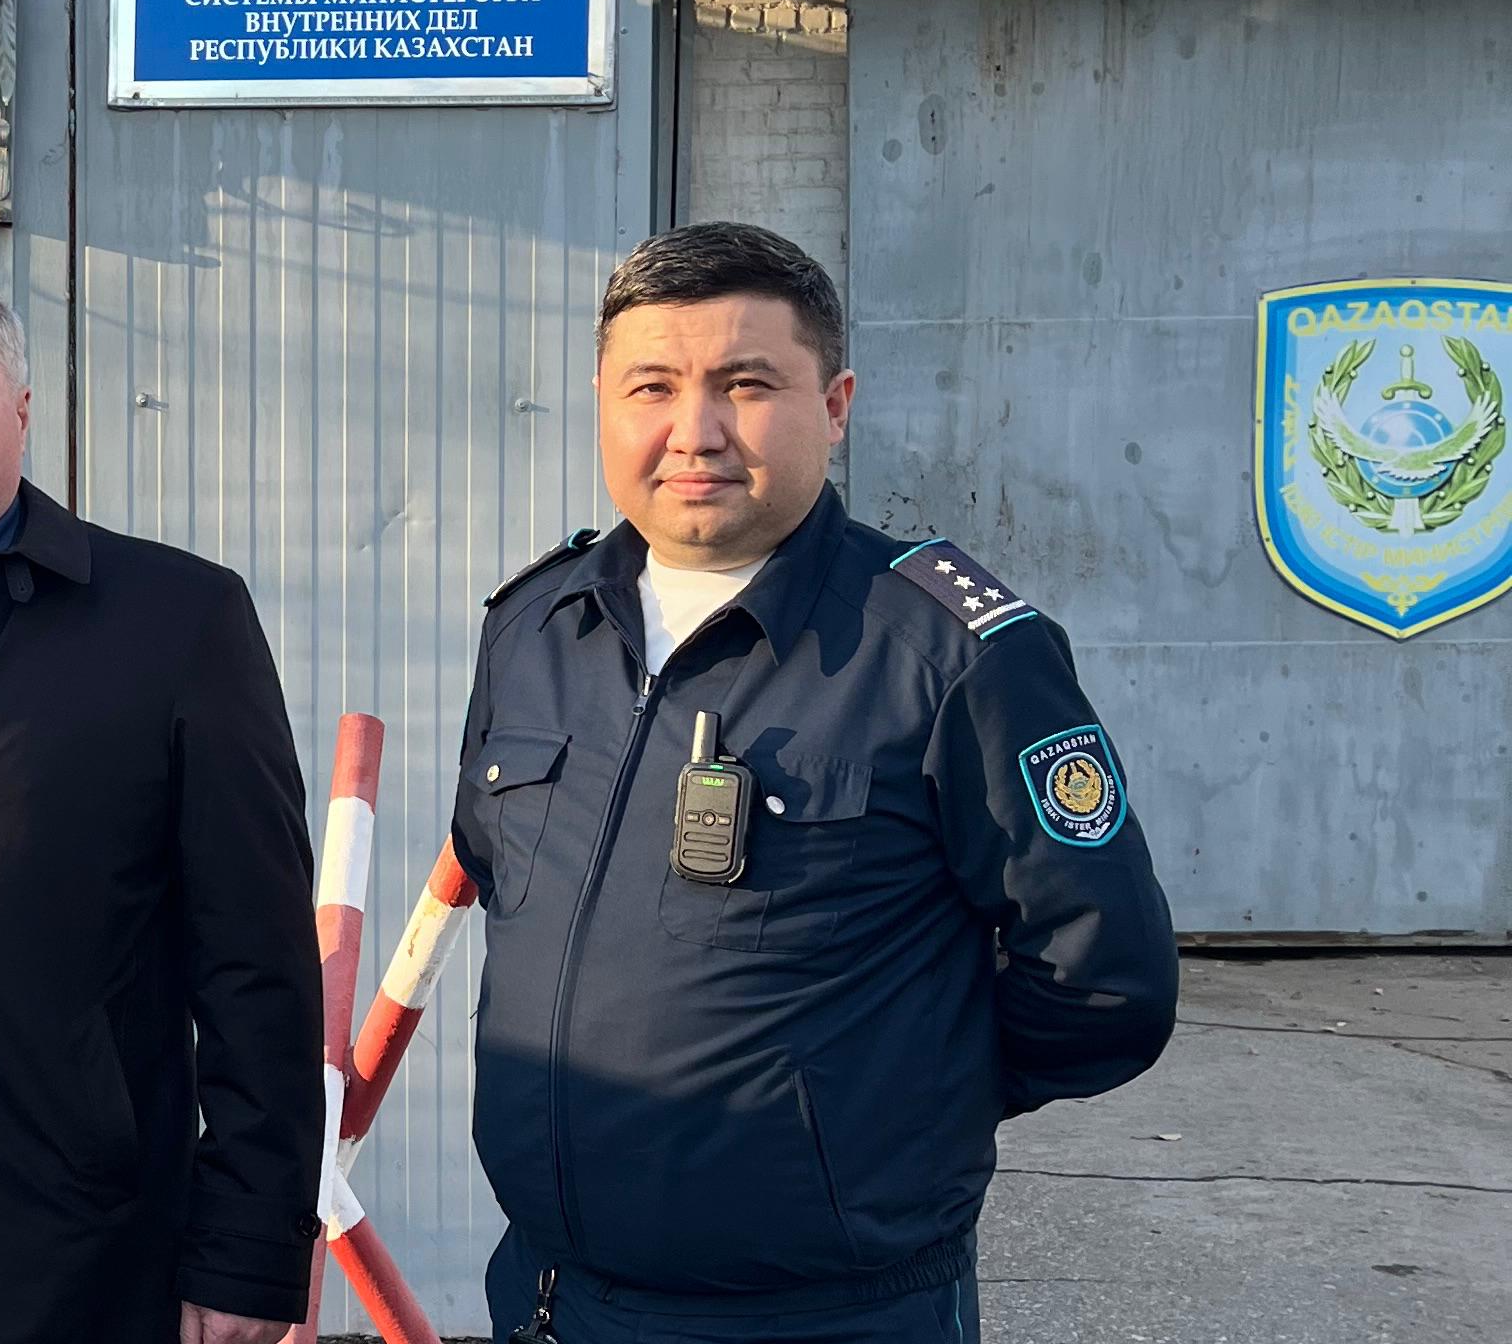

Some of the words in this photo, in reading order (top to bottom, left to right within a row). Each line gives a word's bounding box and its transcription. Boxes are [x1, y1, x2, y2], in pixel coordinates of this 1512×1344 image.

[245, 10, 421, 38] ВНУТРЕННИХ
[426, 9, 479, 35] ДЕЛ
[189, 38, 368, 66] РЕСПУБЛИКИ
[373, 36, 534, 59] КАЗАХСТАН
[1030, 734, 1097, 765] QAZAQSTAN
